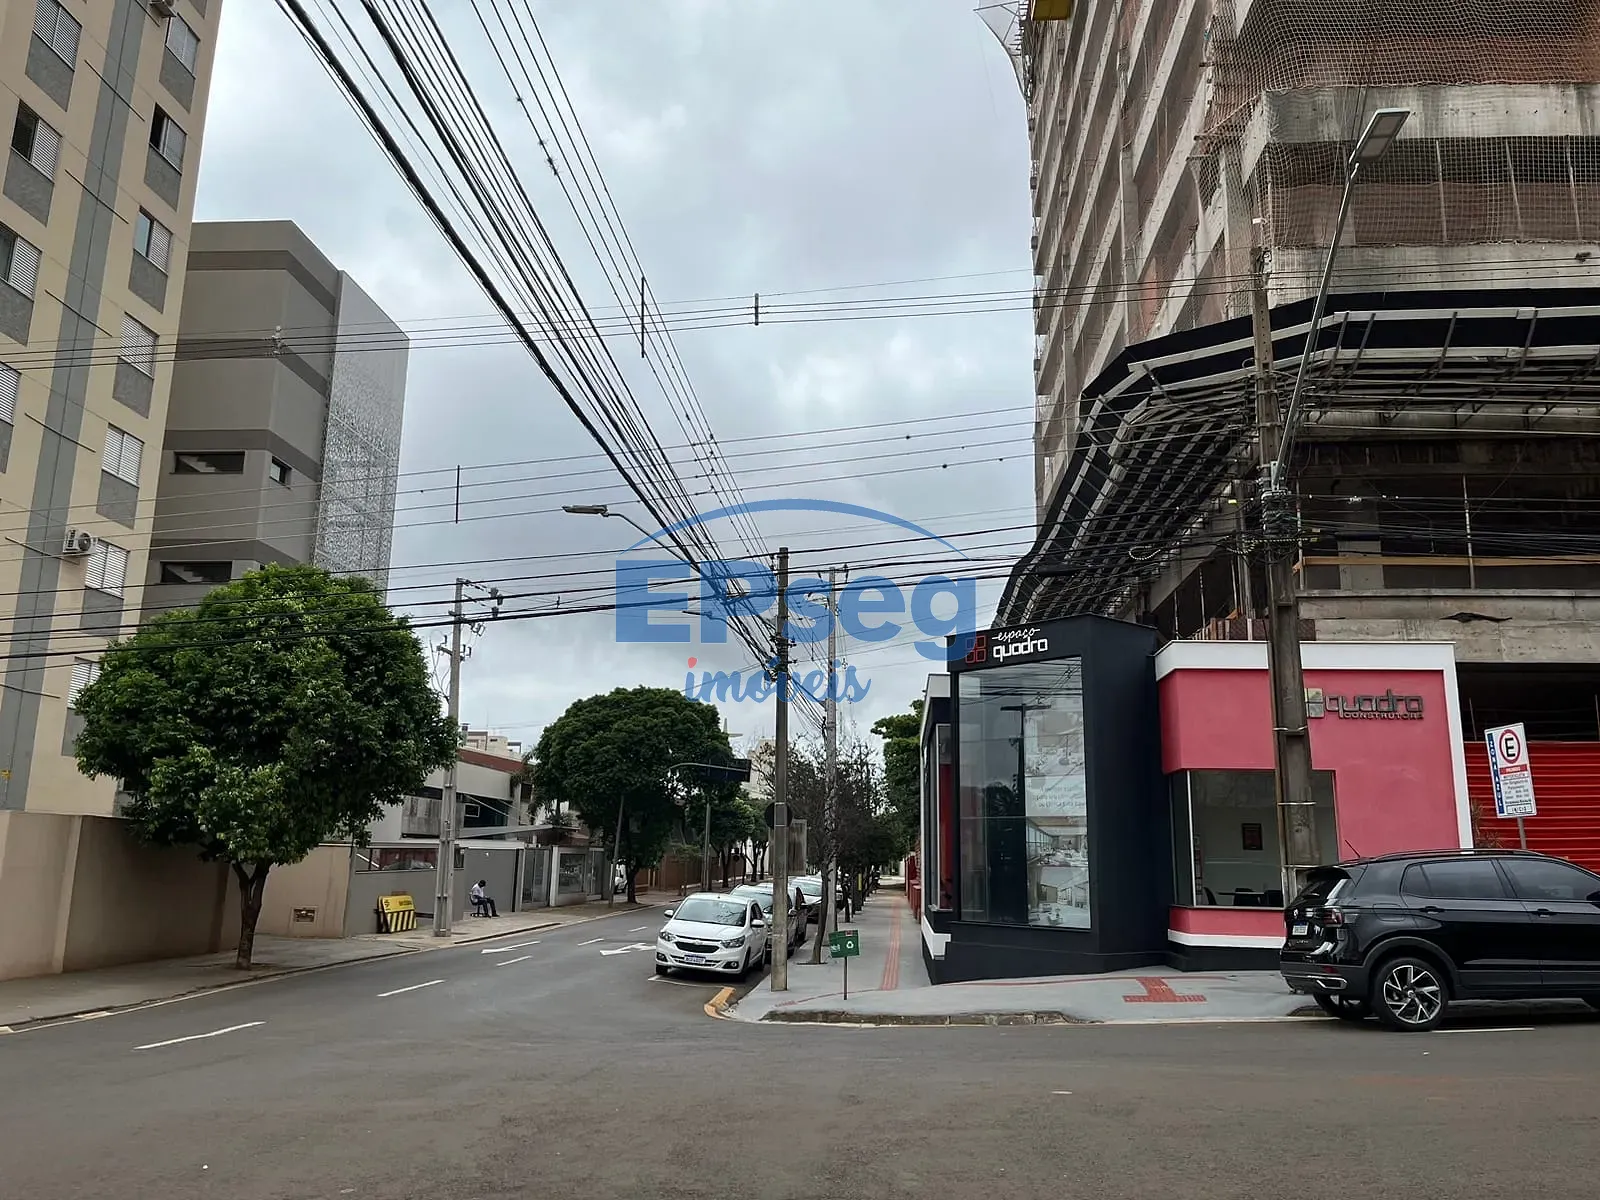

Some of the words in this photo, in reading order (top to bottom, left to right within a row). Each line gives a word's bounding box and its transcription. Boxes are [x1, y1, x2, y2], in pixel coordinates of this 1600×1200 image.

[992, 637, 1048, 663] quadro
[1325, 689, 1424, 717] quadro
[1504, 737, 1516, 758] E
